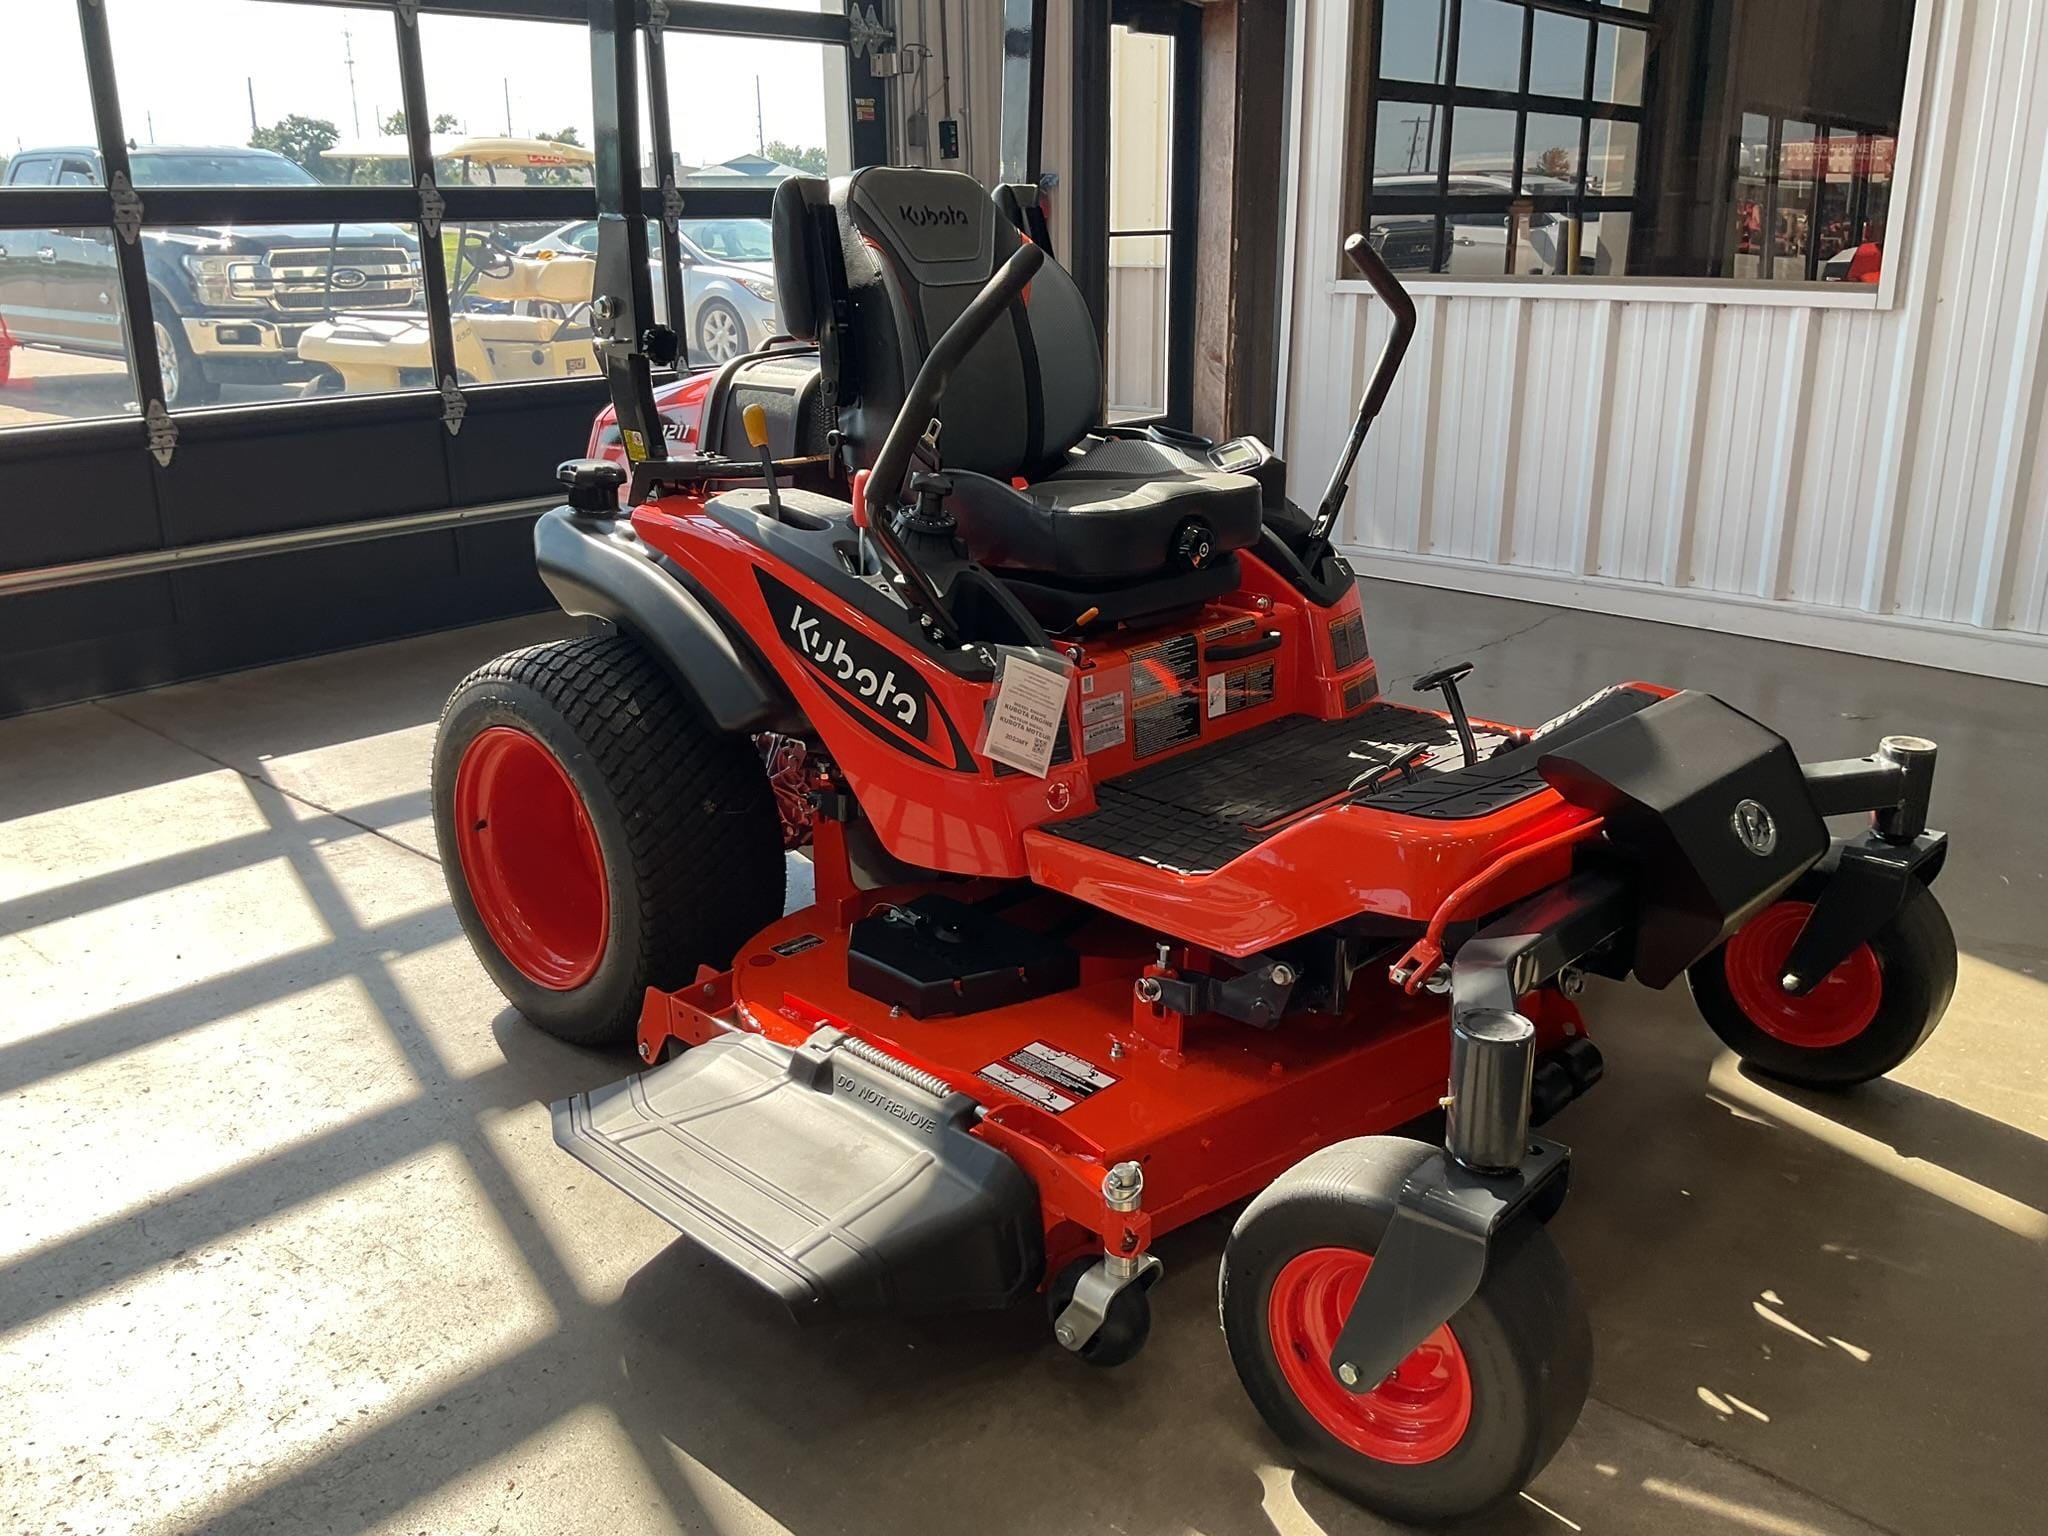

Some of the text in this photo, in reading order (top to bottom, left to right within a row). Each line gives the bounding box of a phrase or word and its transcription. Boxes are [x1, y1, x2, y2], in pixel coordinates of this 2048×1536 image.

[1788, 143, 1885, 154] POWER PRUNERS
[899, 205, 968, 226] Kubota
[790, 604, 917, 725] Kubota
[1004, 703, 1053, 728] KUBOTA ENGINE
[1000, 716, 1051, 741] KUBOTA MOTEUR
[836, 1073, 937, 1134] DO NOT REMOVE
